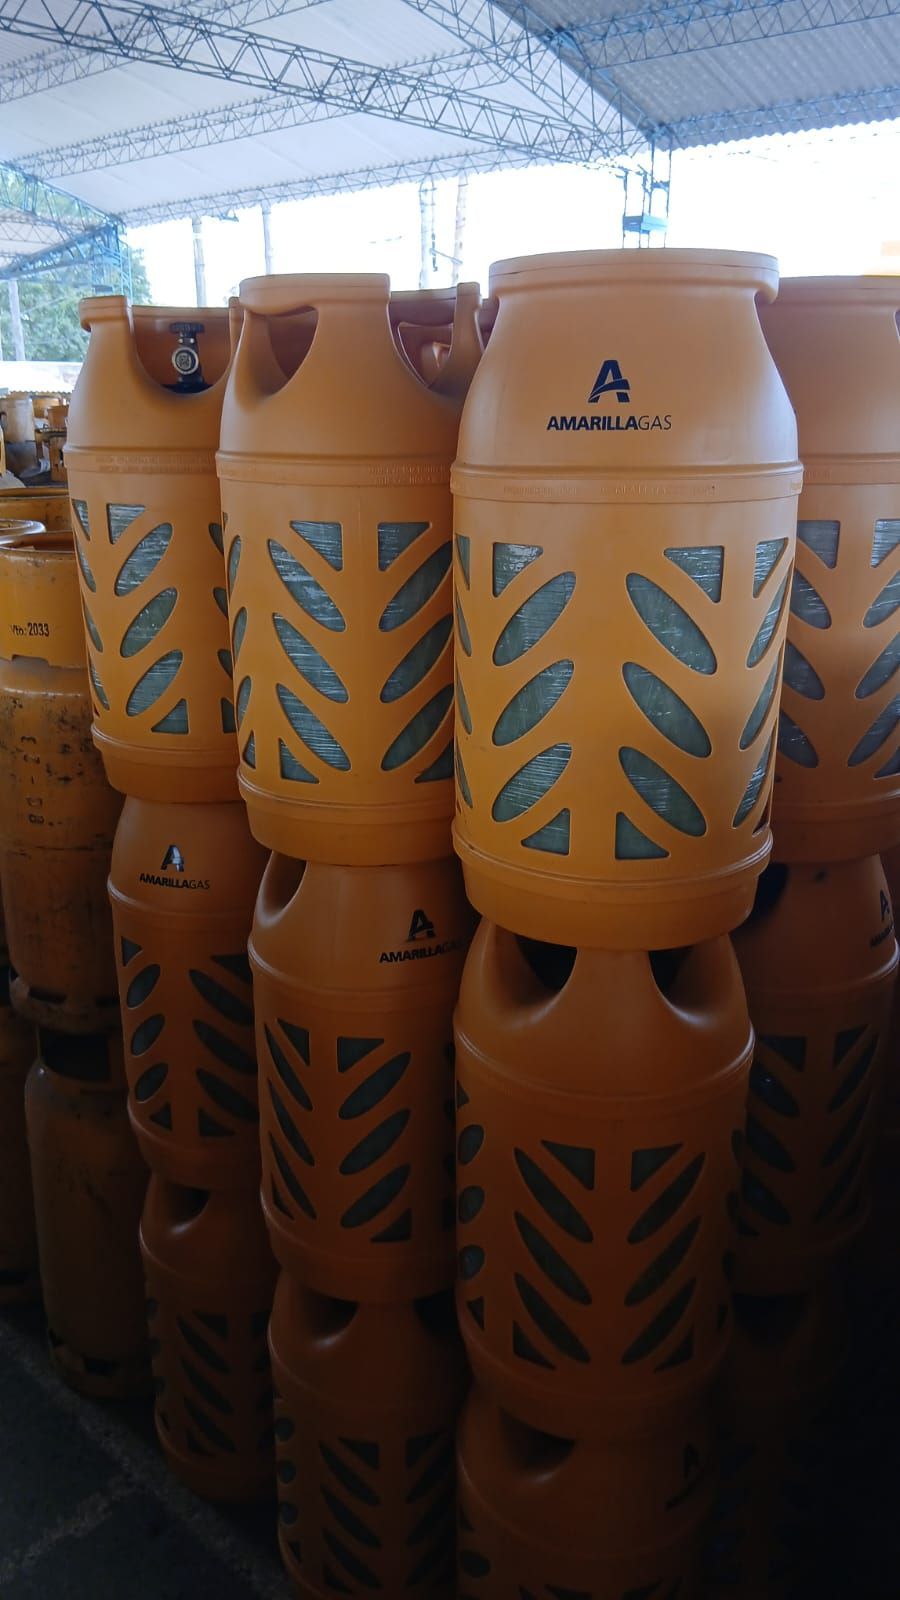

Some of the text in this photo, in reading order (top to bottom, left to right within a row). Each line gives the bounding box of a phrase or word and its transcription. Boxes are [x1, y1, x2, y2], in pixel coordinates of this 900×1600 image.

[547, 415, 672, 431] AMARILLAGAS
[28, 622, 50, 637] 2033
[140, 873, 210, 889] AMARILLAGAS
